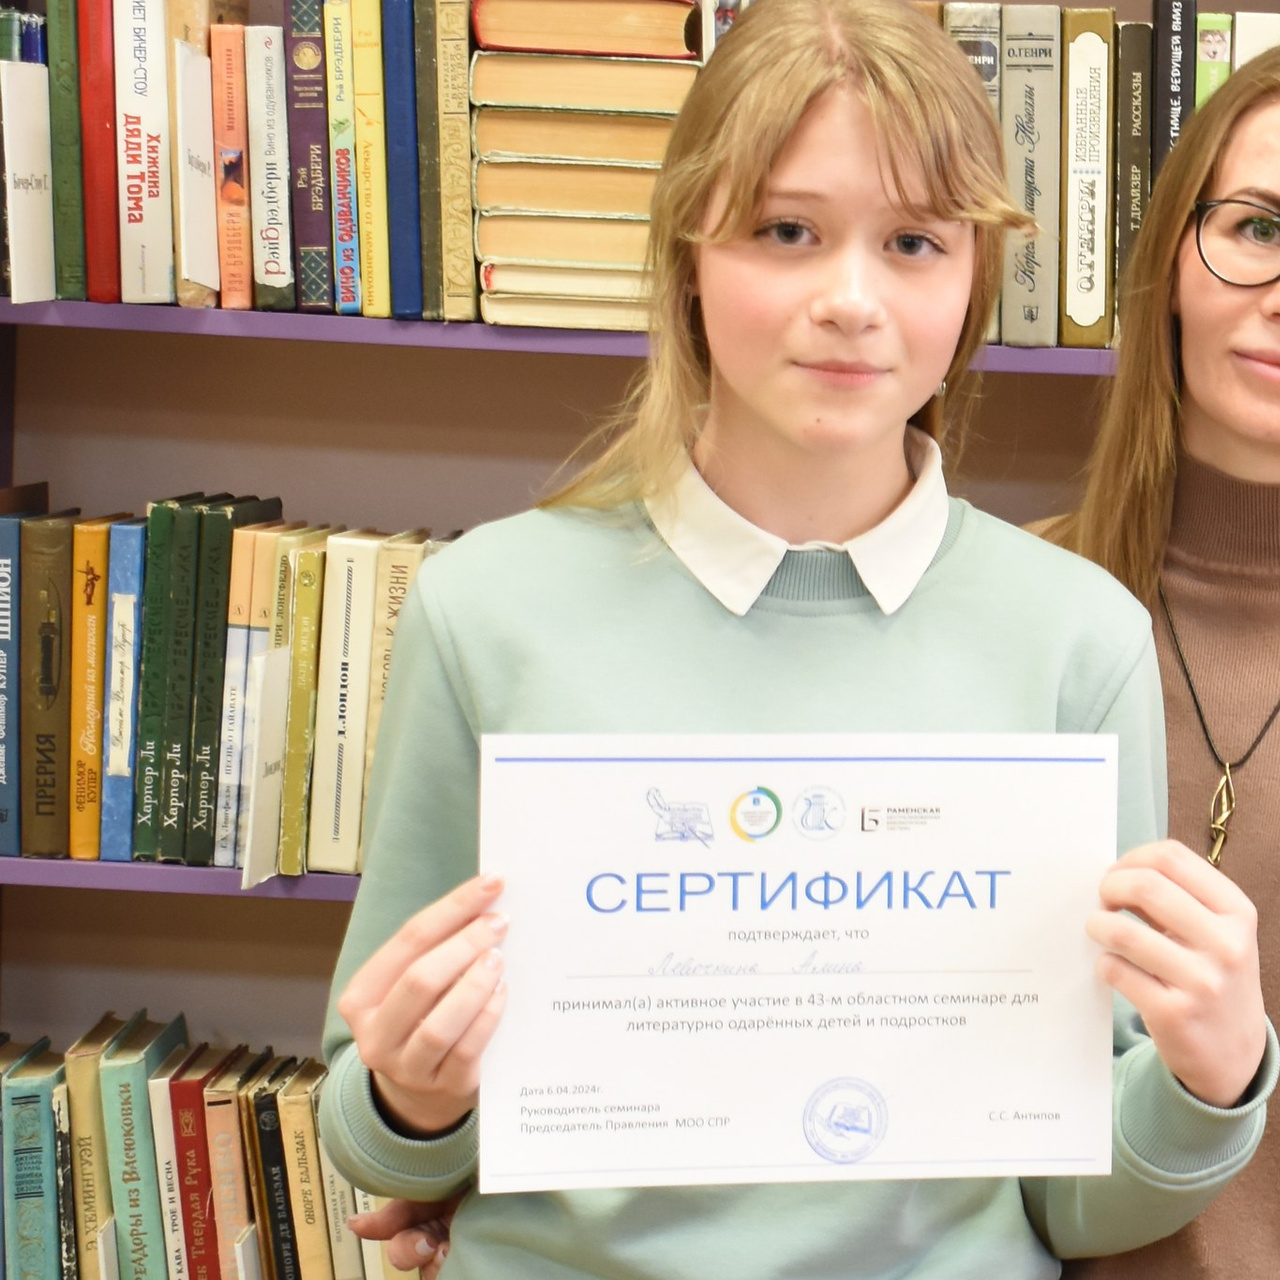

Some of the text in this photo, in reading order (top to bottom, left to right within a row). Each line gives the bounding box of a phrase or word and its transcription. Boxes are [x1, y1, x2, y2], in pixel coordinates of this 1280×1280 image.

[1007, 48, 1052, 59] О.ГЕНРИ
[1132, 72, 1142, 136] РАССКАЗЫ
[146, 134, 161, 198] Хижина
[297, 168, 309, 188] Рэй
[310, 144, 324, 211] БРЭДБЕРИ
[336, 148, 355, 303] ВИНО из ОДУВАНЧИКОВ
[142, 740, 156, 762] Ли
[35, 734, 56, 817] ПРЕРИЯ
[585, 871, 1011, 913] СЕРТИФИКАТ
[728, 928, 869, 942] подтверждает, что
[552, 992, 1039, 1013] принимал(а) активное участие в 43-м областном семинаре для
[626, 1015, 967, 1033] литературно одарённых детей и подростков
[520, 1086, 603, 1098] Дата 6.04.2024г.
[519, 1103, 660, 1119] Руководитель семинара
[1013, 1111, 1060, 1122] Антипов
[519, 1118, 730, 1136] Председатель Правления МОО СПР
[272, 1166, 295, 1280] ОНОРЕ ДЕ БАЛЬЗАК
